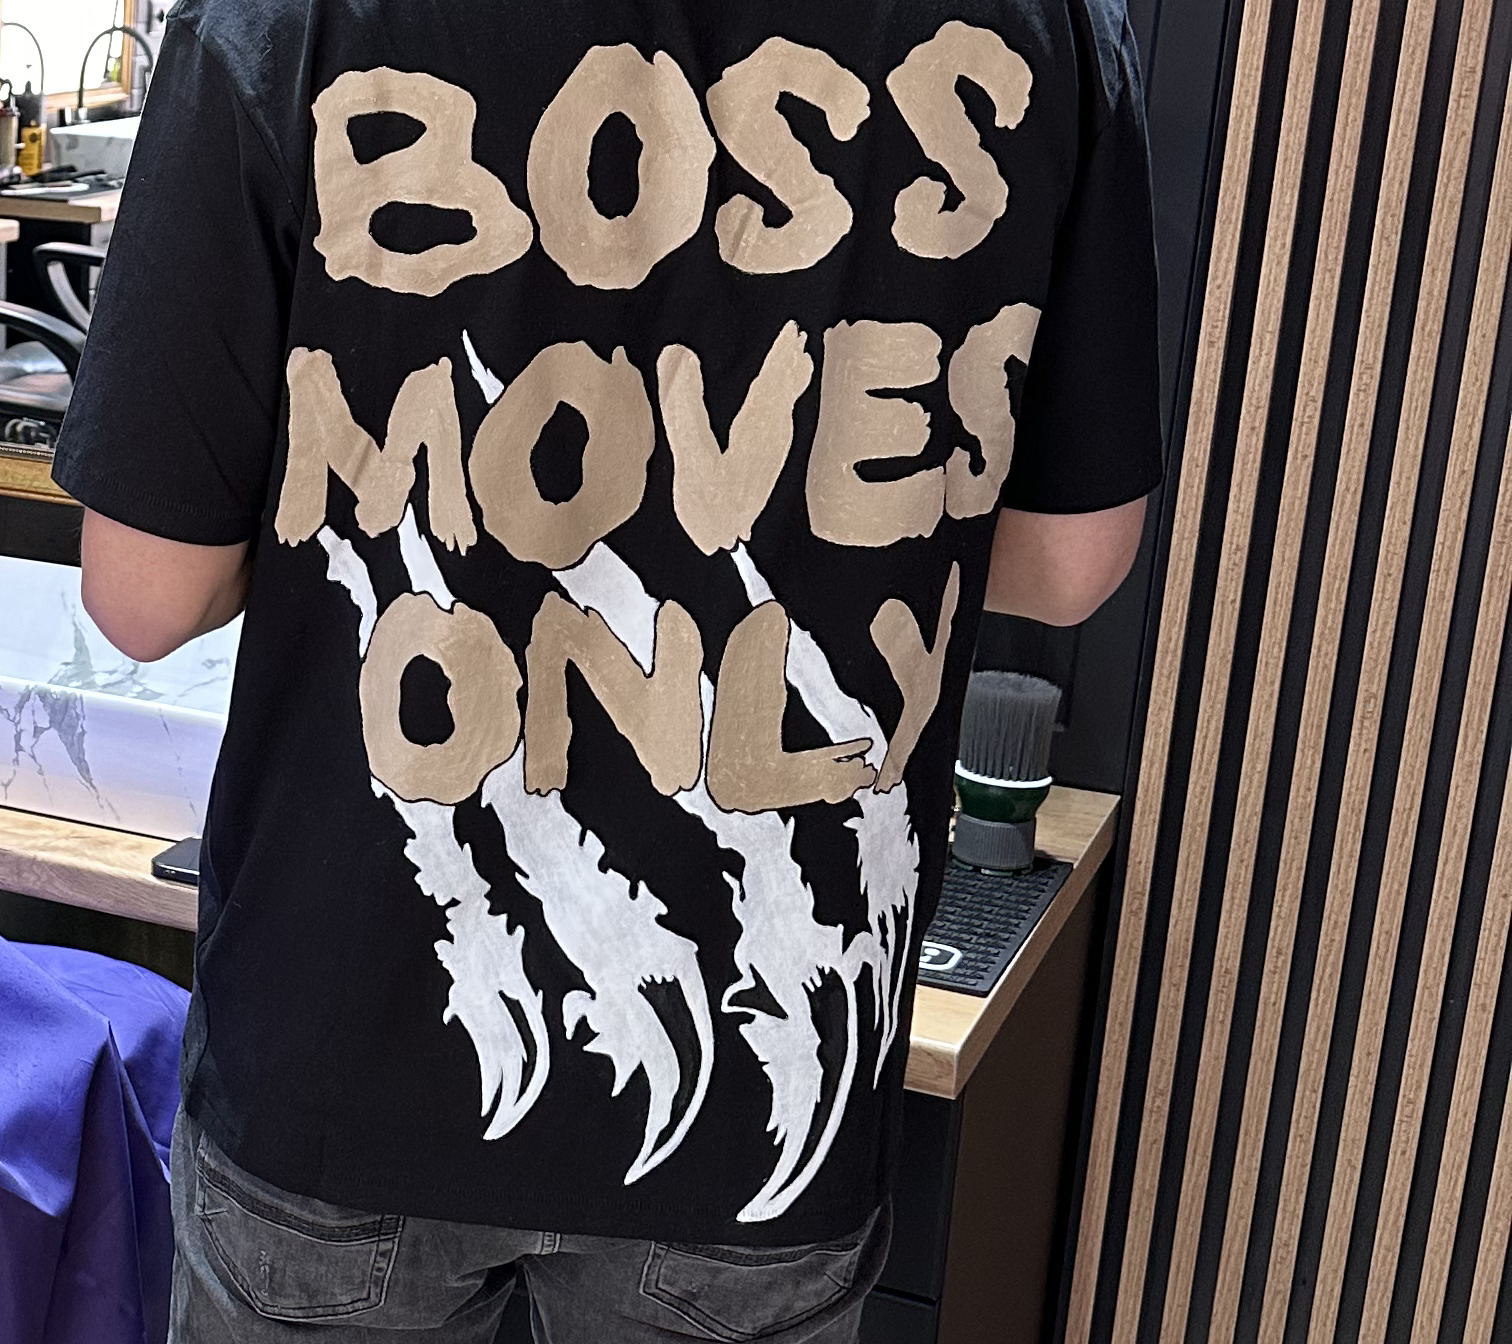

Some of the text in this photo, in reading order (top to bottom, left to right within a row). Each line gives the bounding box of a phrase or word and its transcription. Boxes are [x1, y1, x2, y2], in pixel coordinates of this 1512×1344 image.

[312, 20, 1034, 296] BOSS
[275, 303, 1042, 570] MOVES
[360, 561, 960, 813] ONLY
